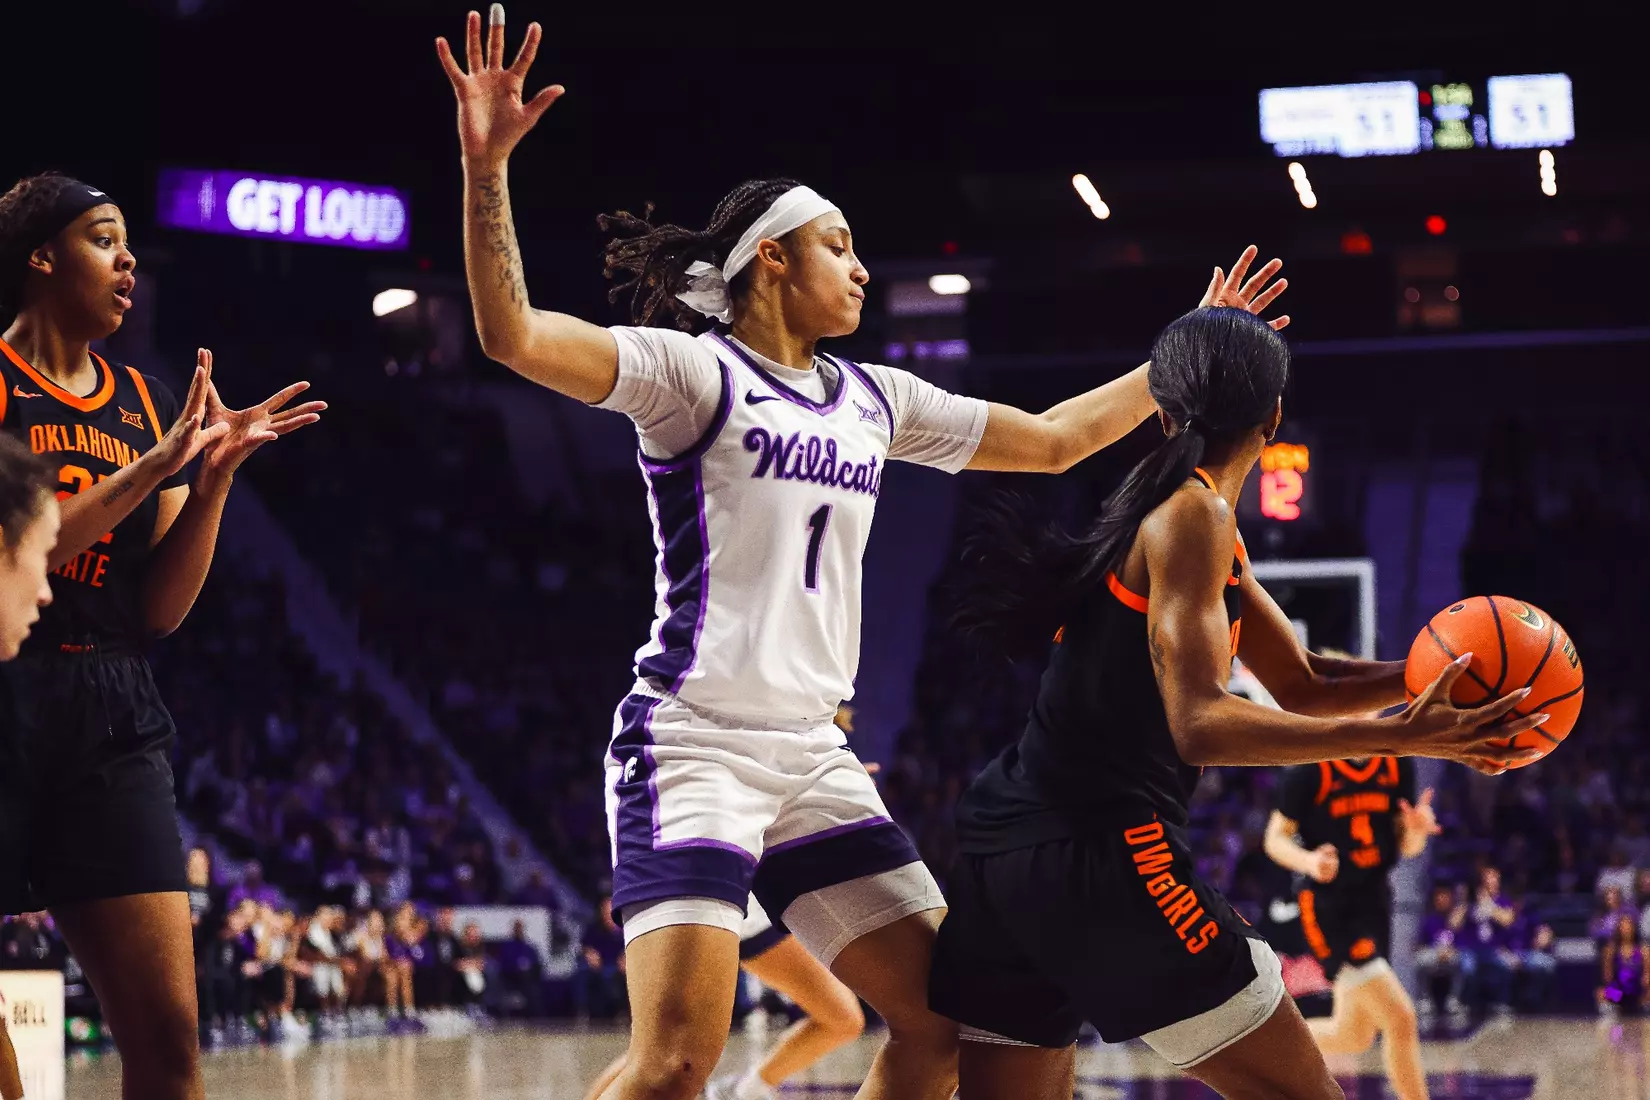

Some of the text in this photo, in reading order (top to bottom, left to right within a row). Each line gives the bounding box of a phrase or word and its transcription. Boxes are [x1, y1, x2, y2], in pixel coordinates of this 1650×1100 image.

[226, 178, 405, 243] GET LOUD
[54, 550, 110, 587] ATE
[804, 502, 833, 594] 1
[1124, 812, 1219, 954] OWGIRLS
